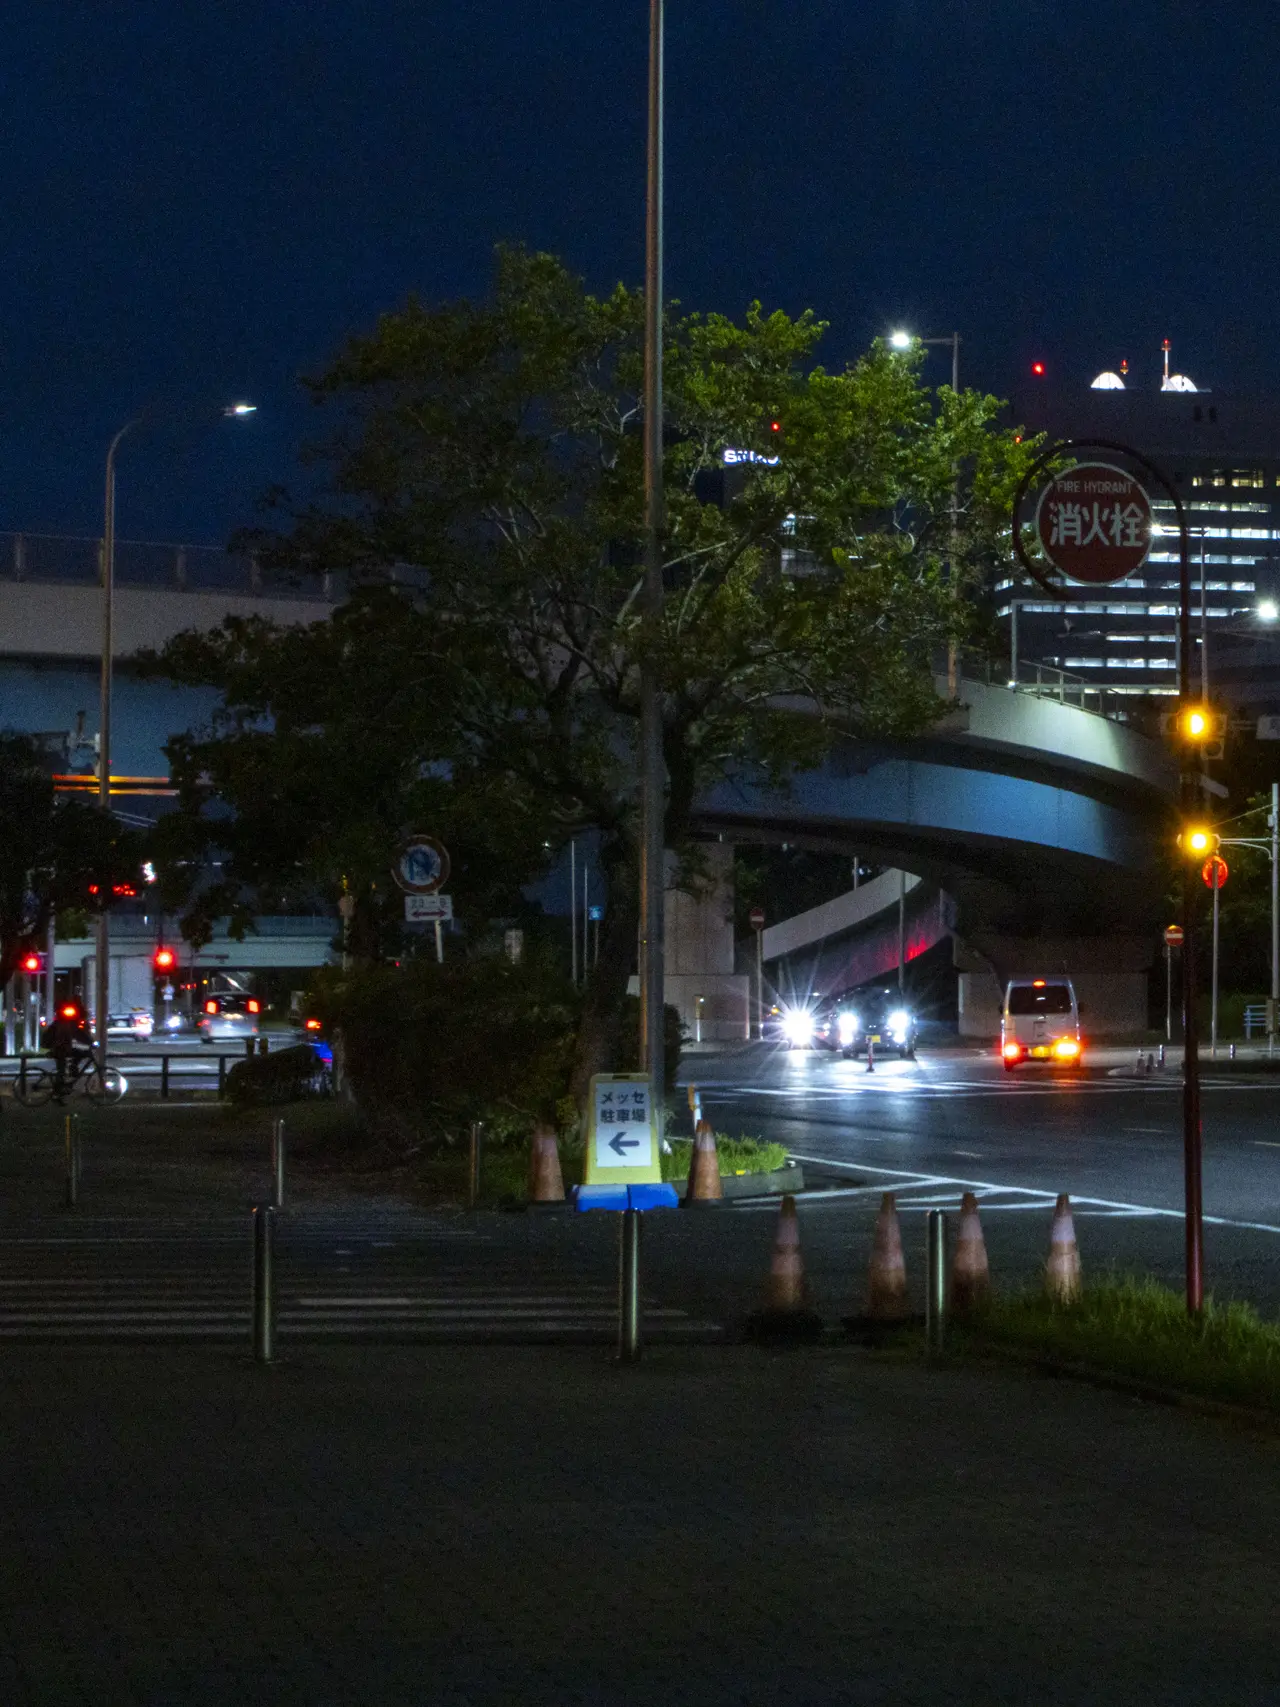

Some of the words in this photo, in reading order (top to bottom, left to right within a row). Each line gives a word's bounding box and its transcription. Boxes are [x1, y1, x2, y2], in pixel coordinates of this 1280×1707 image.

[1057, 480, 1080, 493] FIRE
[1083, 480, 1133, 494] HYDRANT
[1049, 502, 1143, 547] 消火栓
[600, 1089, 645, 1105] メッセ
[600, 1108, 645, 1124] 駐車場
